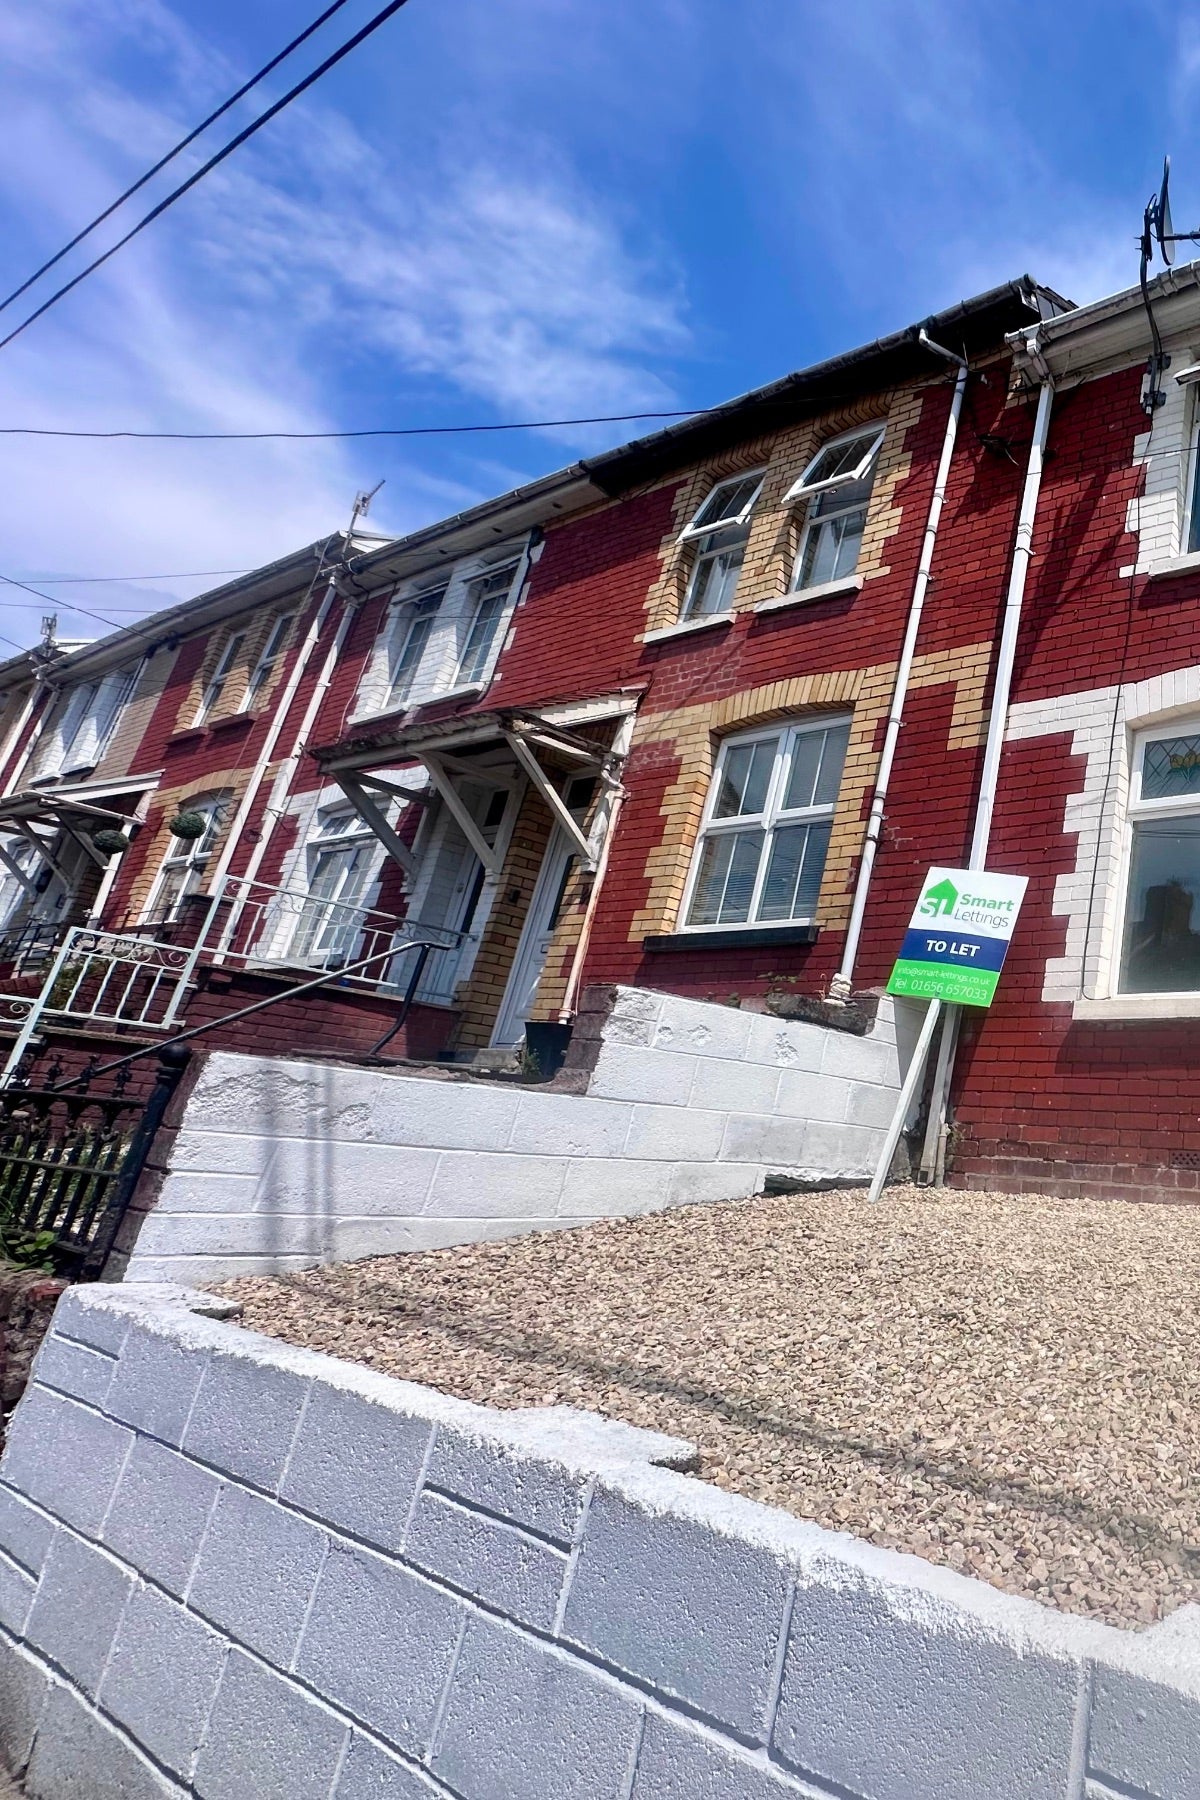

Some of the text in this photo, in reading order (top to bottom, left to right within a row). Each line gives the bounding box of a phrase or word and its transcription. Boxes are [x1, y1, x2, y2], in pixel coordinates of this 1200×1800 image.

[959, 893, 1015, 912] Smart
[954, 908, 1009, 929] Lettings
[926, 940, 980, 957] TO LET
[911, 979, 944, 993] 01656
[945, 984, 988, 1001] 657033
